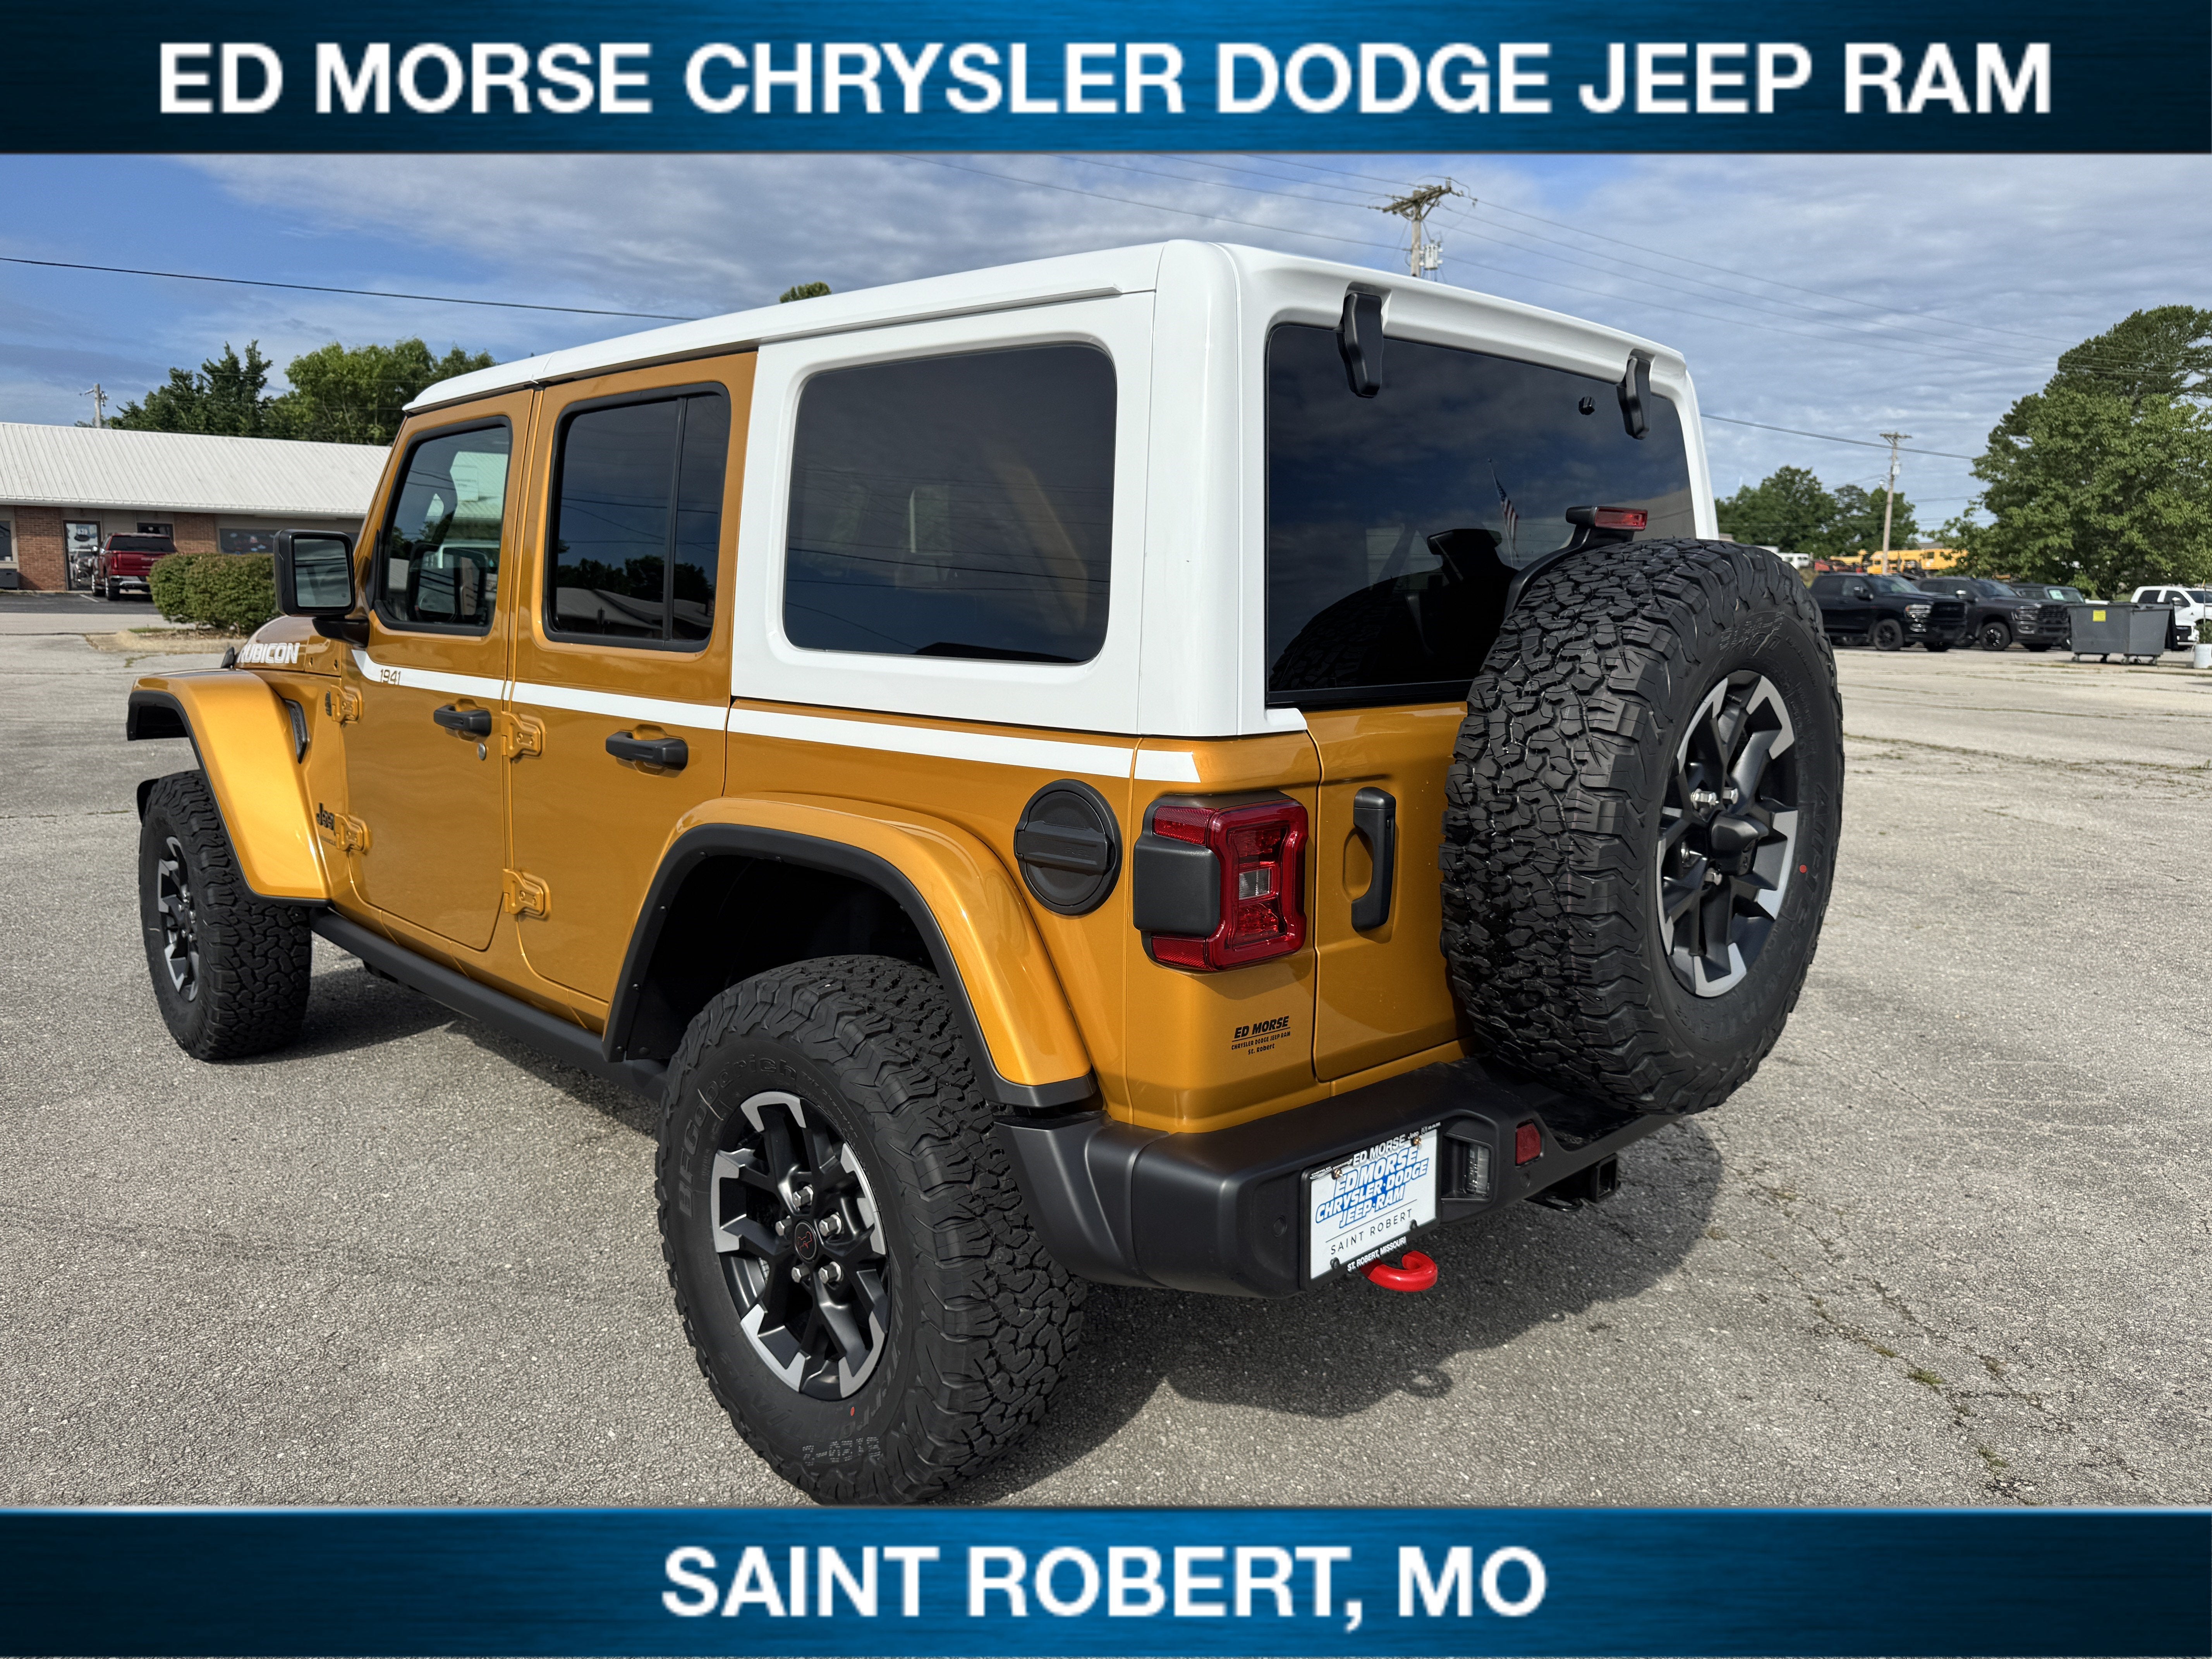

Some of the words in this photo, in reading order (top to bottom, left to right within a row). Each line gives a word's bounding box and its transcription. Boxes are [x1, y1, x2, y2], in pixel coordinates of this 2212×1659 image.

[237, 642, 300, 664] RUBICON
[380, 669, 401, 685] 1941
[1234, 1026, 1249, 1039] ED
[1252, 1015, 1290, 1035] MORSE
[1231, 1040, 1254, 1050] CHRYSLER
[1255, 1037, 1269, 1045] DODGE
[1257, 1043, 1275, 1053] Robert
[1353, 1150, 1367, 1166] ED
[1369, 1133, 1406, 1160] MORSE
[1334, 1169, 1358, 1198] ED
[1358, 1146, 1418, 1188] MORSE
[1331, 1231, 1364, 1255] SAINT
[1370, 1209, 1412, 1236] ROBERT
[1347, 1261, 1356, 1272] ST.
[1357, 1249, 1380, 1267] ROBERT,
[1380, 1236, 1407, 1256] MISSOURI
